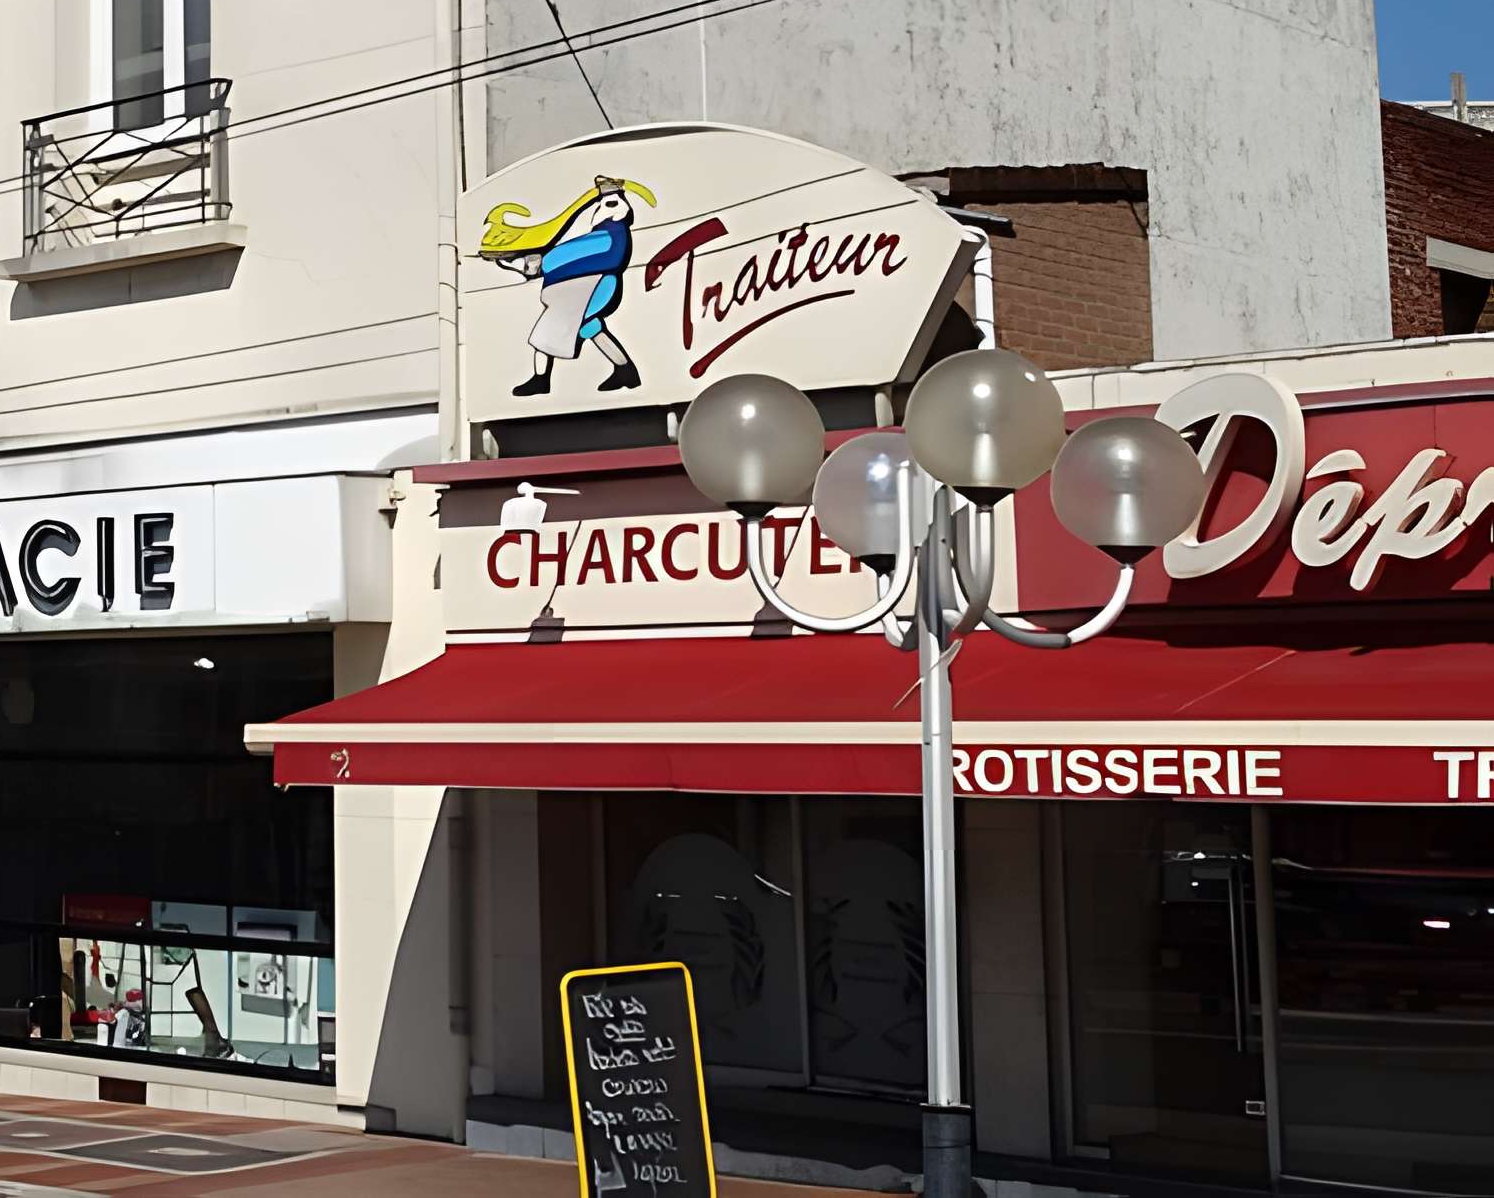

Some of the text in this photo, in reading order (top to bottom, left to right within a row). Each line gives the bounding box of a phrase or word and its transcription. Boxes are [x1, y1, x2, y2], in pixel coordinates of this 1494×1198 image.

[644, 217, 906, 351] Traiteur
[487, 515, 862, 588] CHARCUTE
[952, 749, 1284, 796] ROTISSERIE
